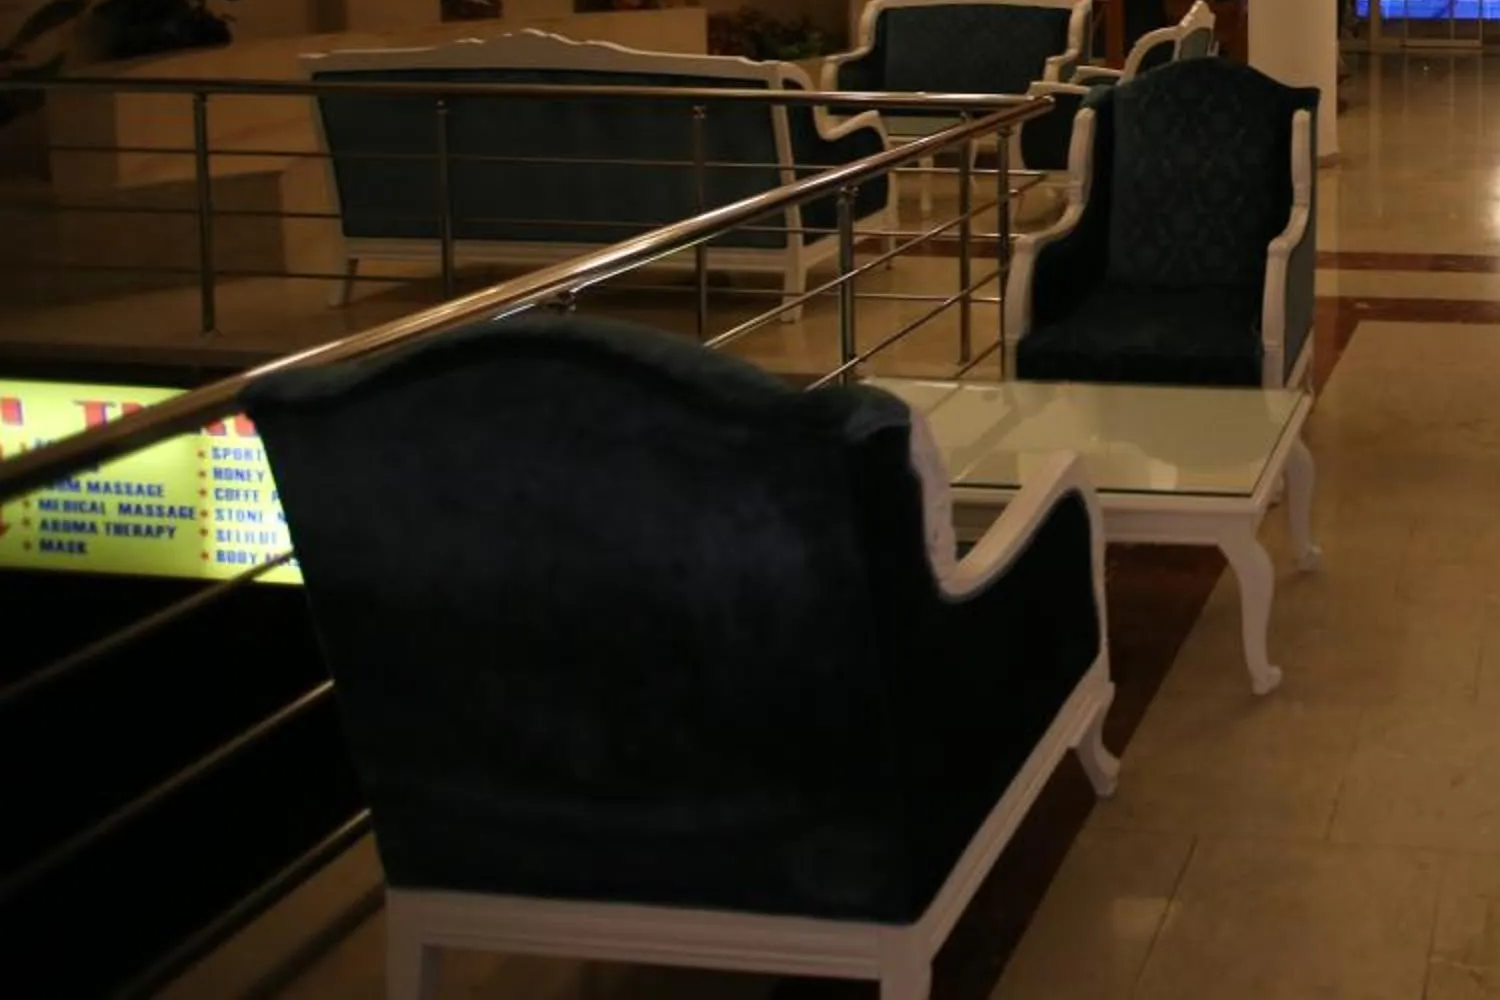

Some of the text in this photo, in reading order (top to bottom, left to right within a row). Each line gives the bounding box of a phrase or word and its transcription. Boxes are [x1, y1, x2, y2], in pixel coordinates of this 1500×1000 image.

[212, 447, 263, 461] SPORT
[213, 467, 264, 482] HONEY
[87, 480, 164, 497] MASSAGE
[38, 499, 195, 520] MEDICAL MASSAGE
[39, 519, 176, 538] AROMA THERAPY
[38, 538, 87, 555] MASK
[216, 549, 256, 564] BODY
